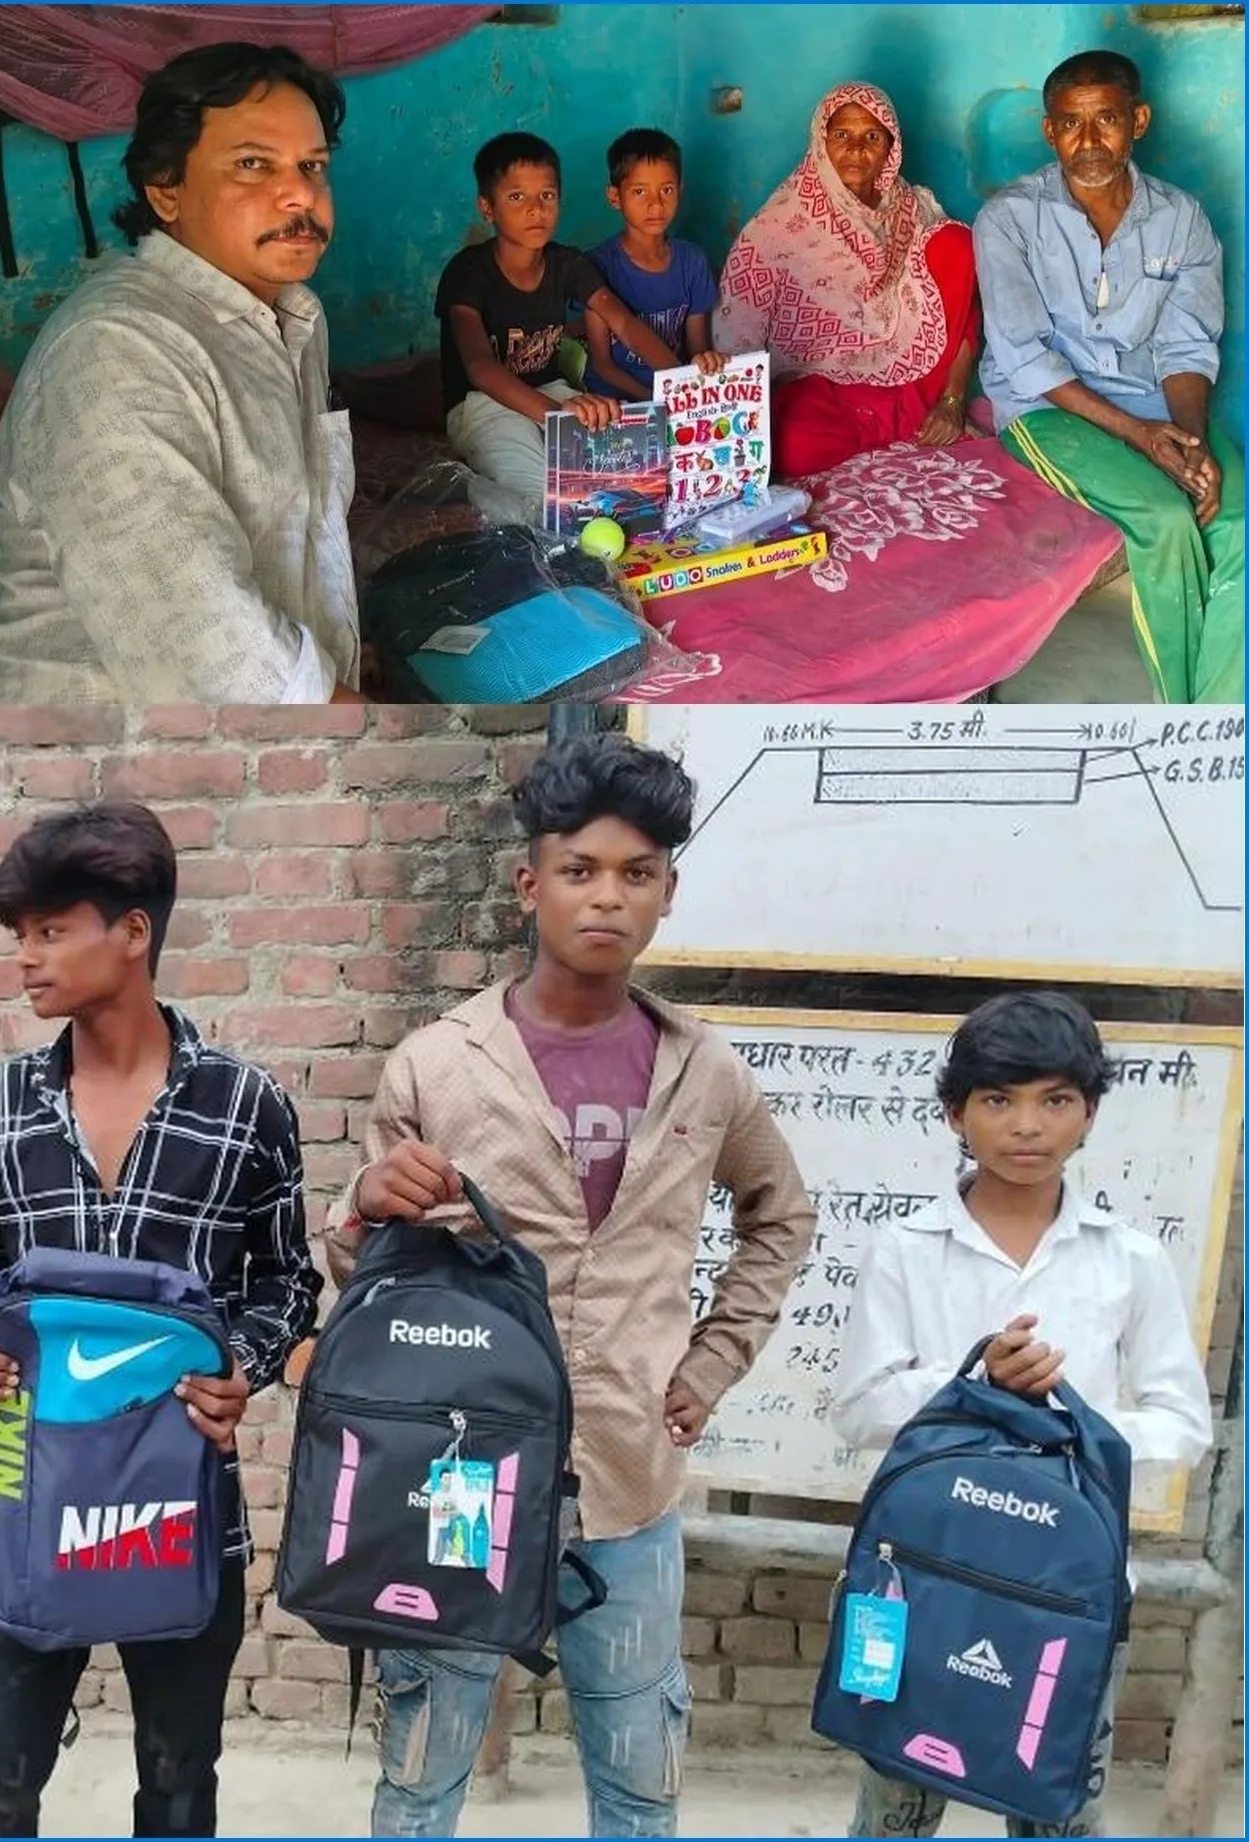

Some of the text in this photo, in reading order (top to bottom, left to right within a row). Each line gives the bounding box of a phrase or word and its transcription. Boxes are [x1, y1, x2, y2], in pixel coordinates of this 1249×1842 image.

[702, 385, 720, 405] IN
[723, 383, 762, 402] ONE
[645, 568, 703, 594] LUDO
[706, 561, 743, 578] Snakes
[907, 721, 956, 740] 3.75
[389, 1319, 491, 1350] Reebok
[951, 1476, 1061, 1528] Reebok
[55, 1501, 199, 1571] NIKE
[946, 1654, 1013, 1689] Reebok
